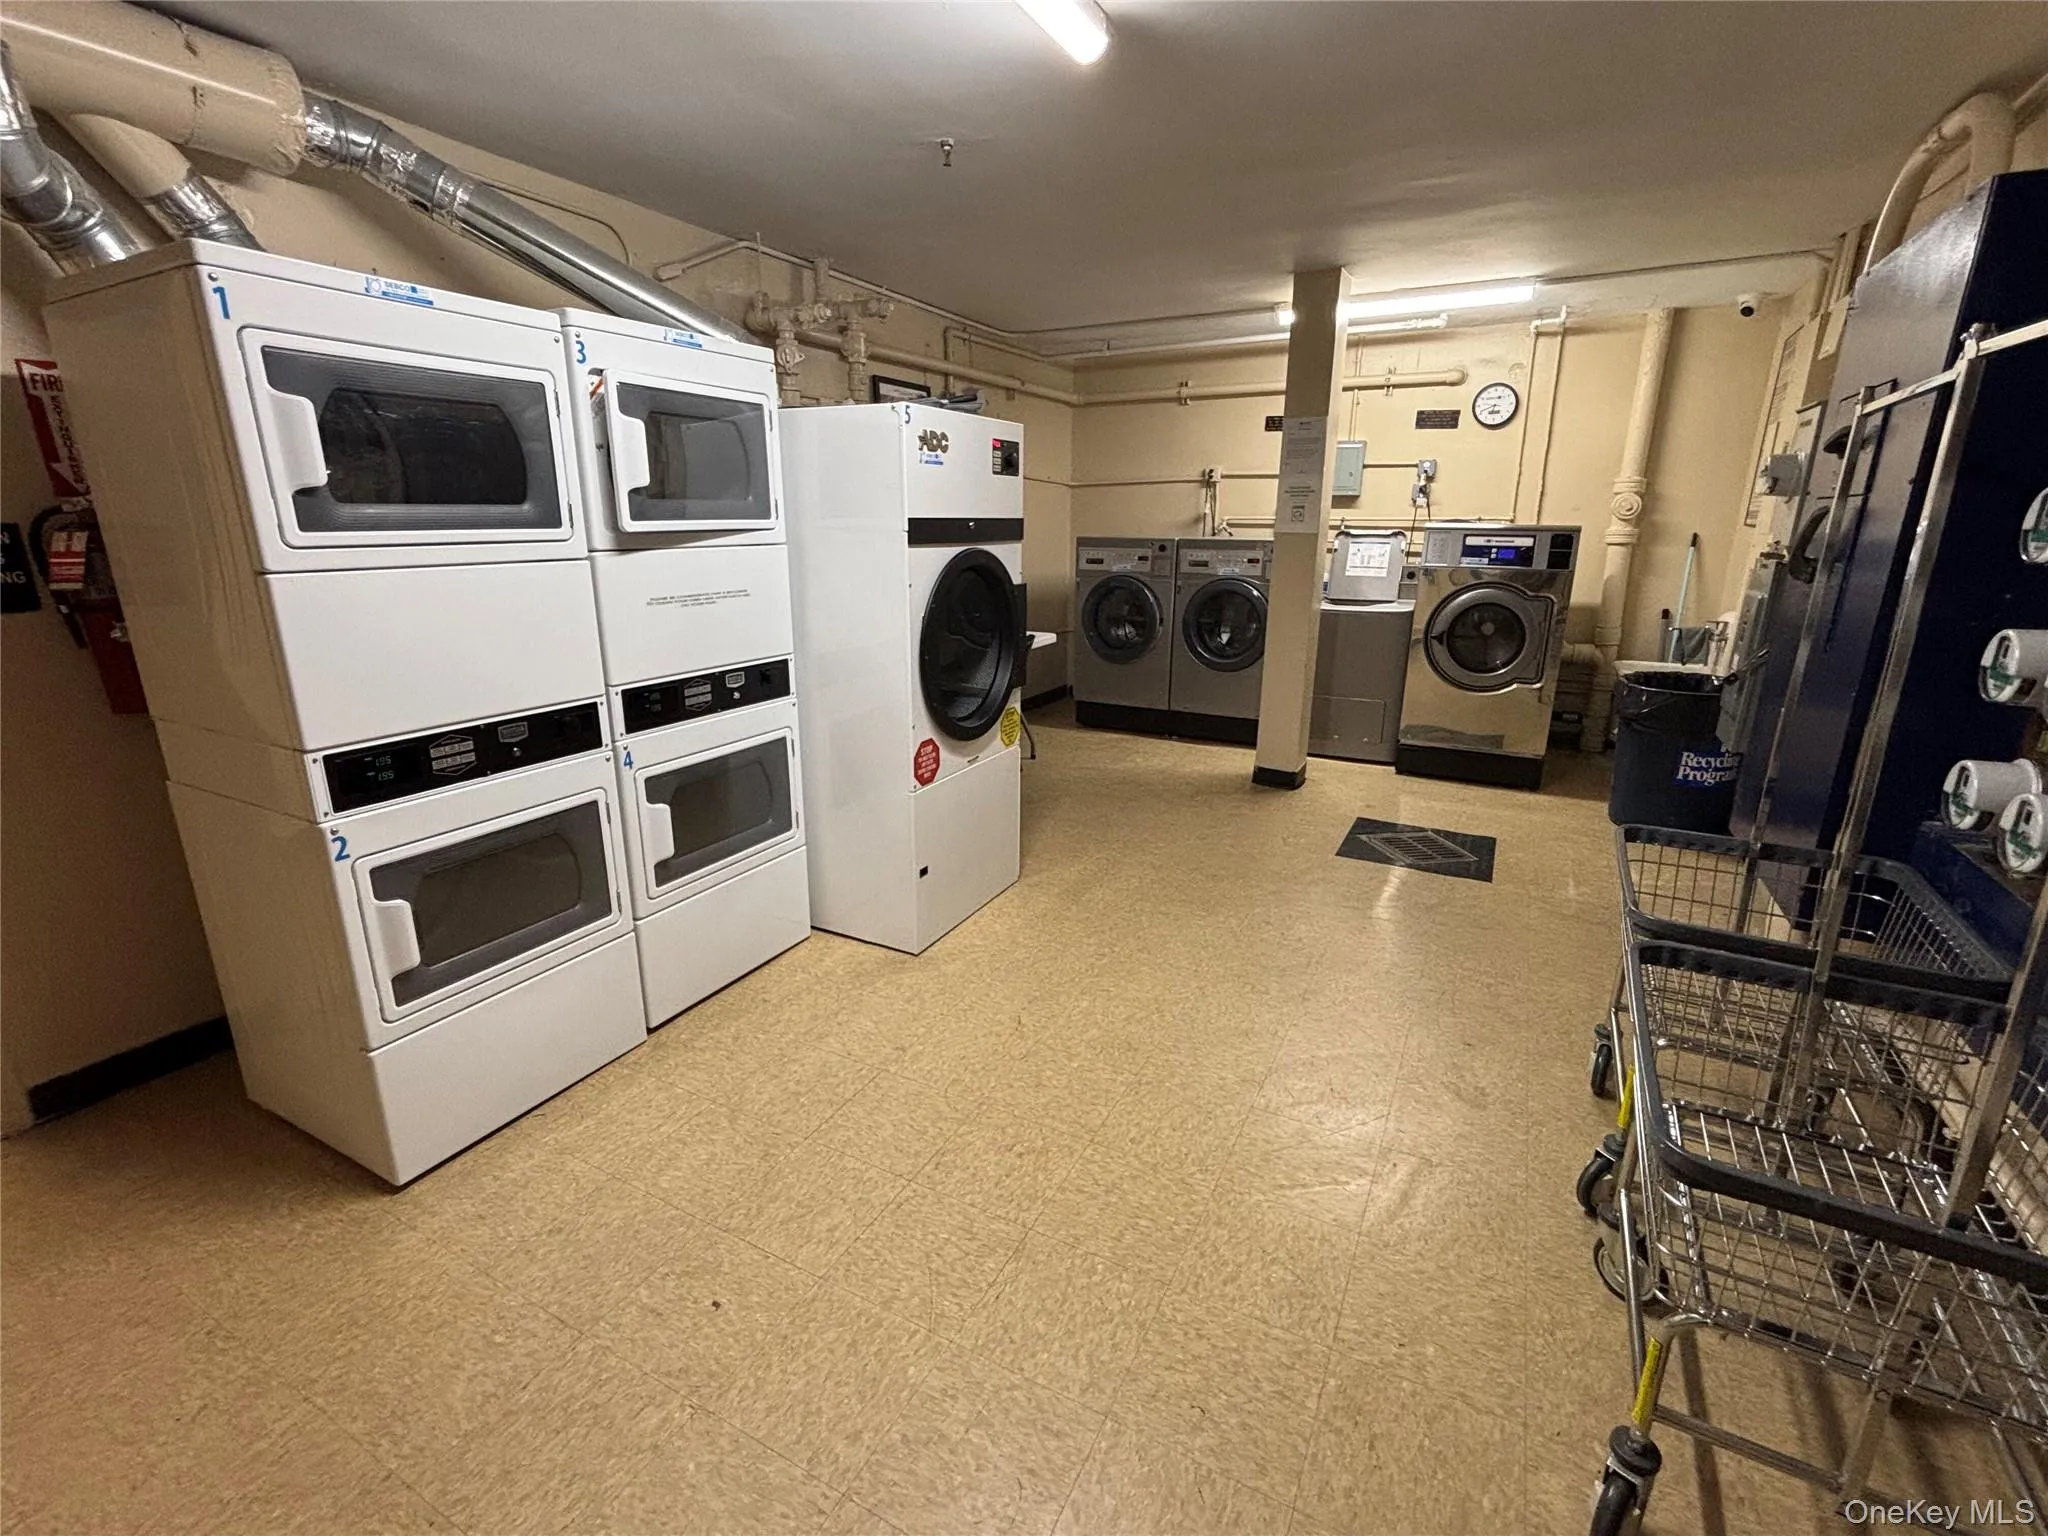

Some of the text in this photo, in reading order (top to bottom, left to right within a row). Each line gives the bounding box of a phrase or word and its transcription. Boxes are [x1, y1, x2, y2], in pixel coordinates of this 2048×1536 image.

[213, 286, 230, 319] 1
[575, 340, 587, 364] 3
[905, 405, 911, 424] 5
[918, 429, 949, 454] ADC
[623, 750, 634, 770] 4
[331, 836, 351, 862] 2
